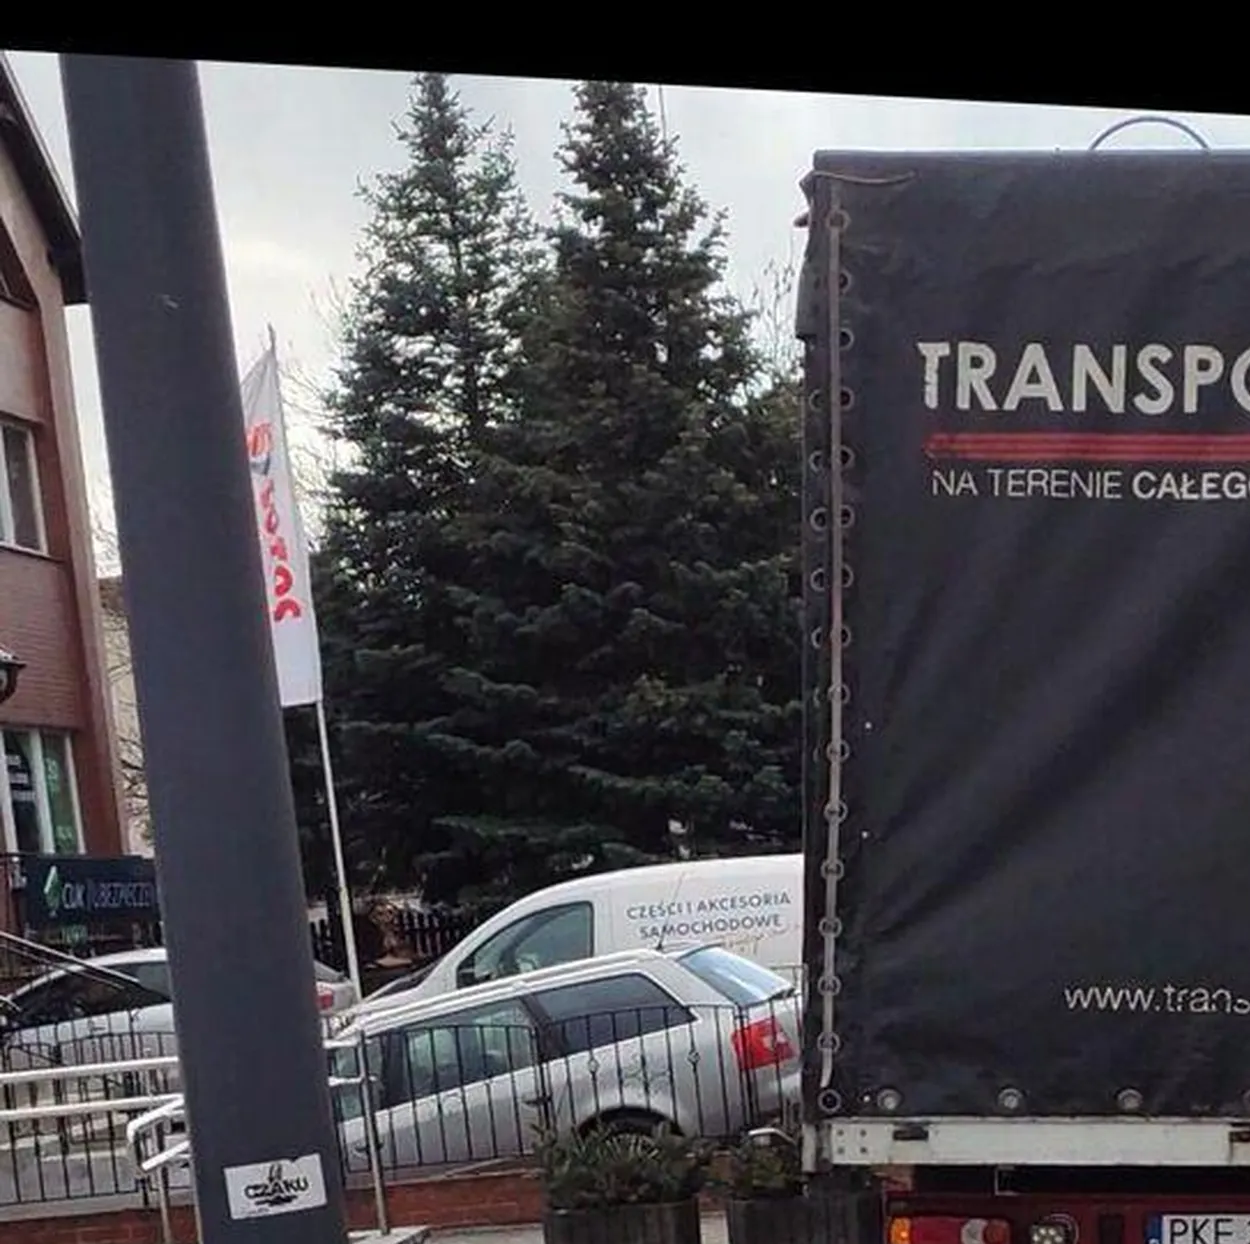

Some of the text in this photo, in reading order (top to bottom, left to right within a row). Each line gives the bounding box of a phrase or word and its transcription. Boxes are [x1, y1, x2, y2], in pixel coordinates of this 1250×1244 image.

[932, 469, 978, 498] NA
[989, 470, 1123, 499] TERENIE
[696, 890, 792, 913] AKCESORIA
[639, 913, 782, 940] SAMOCHODOWE
